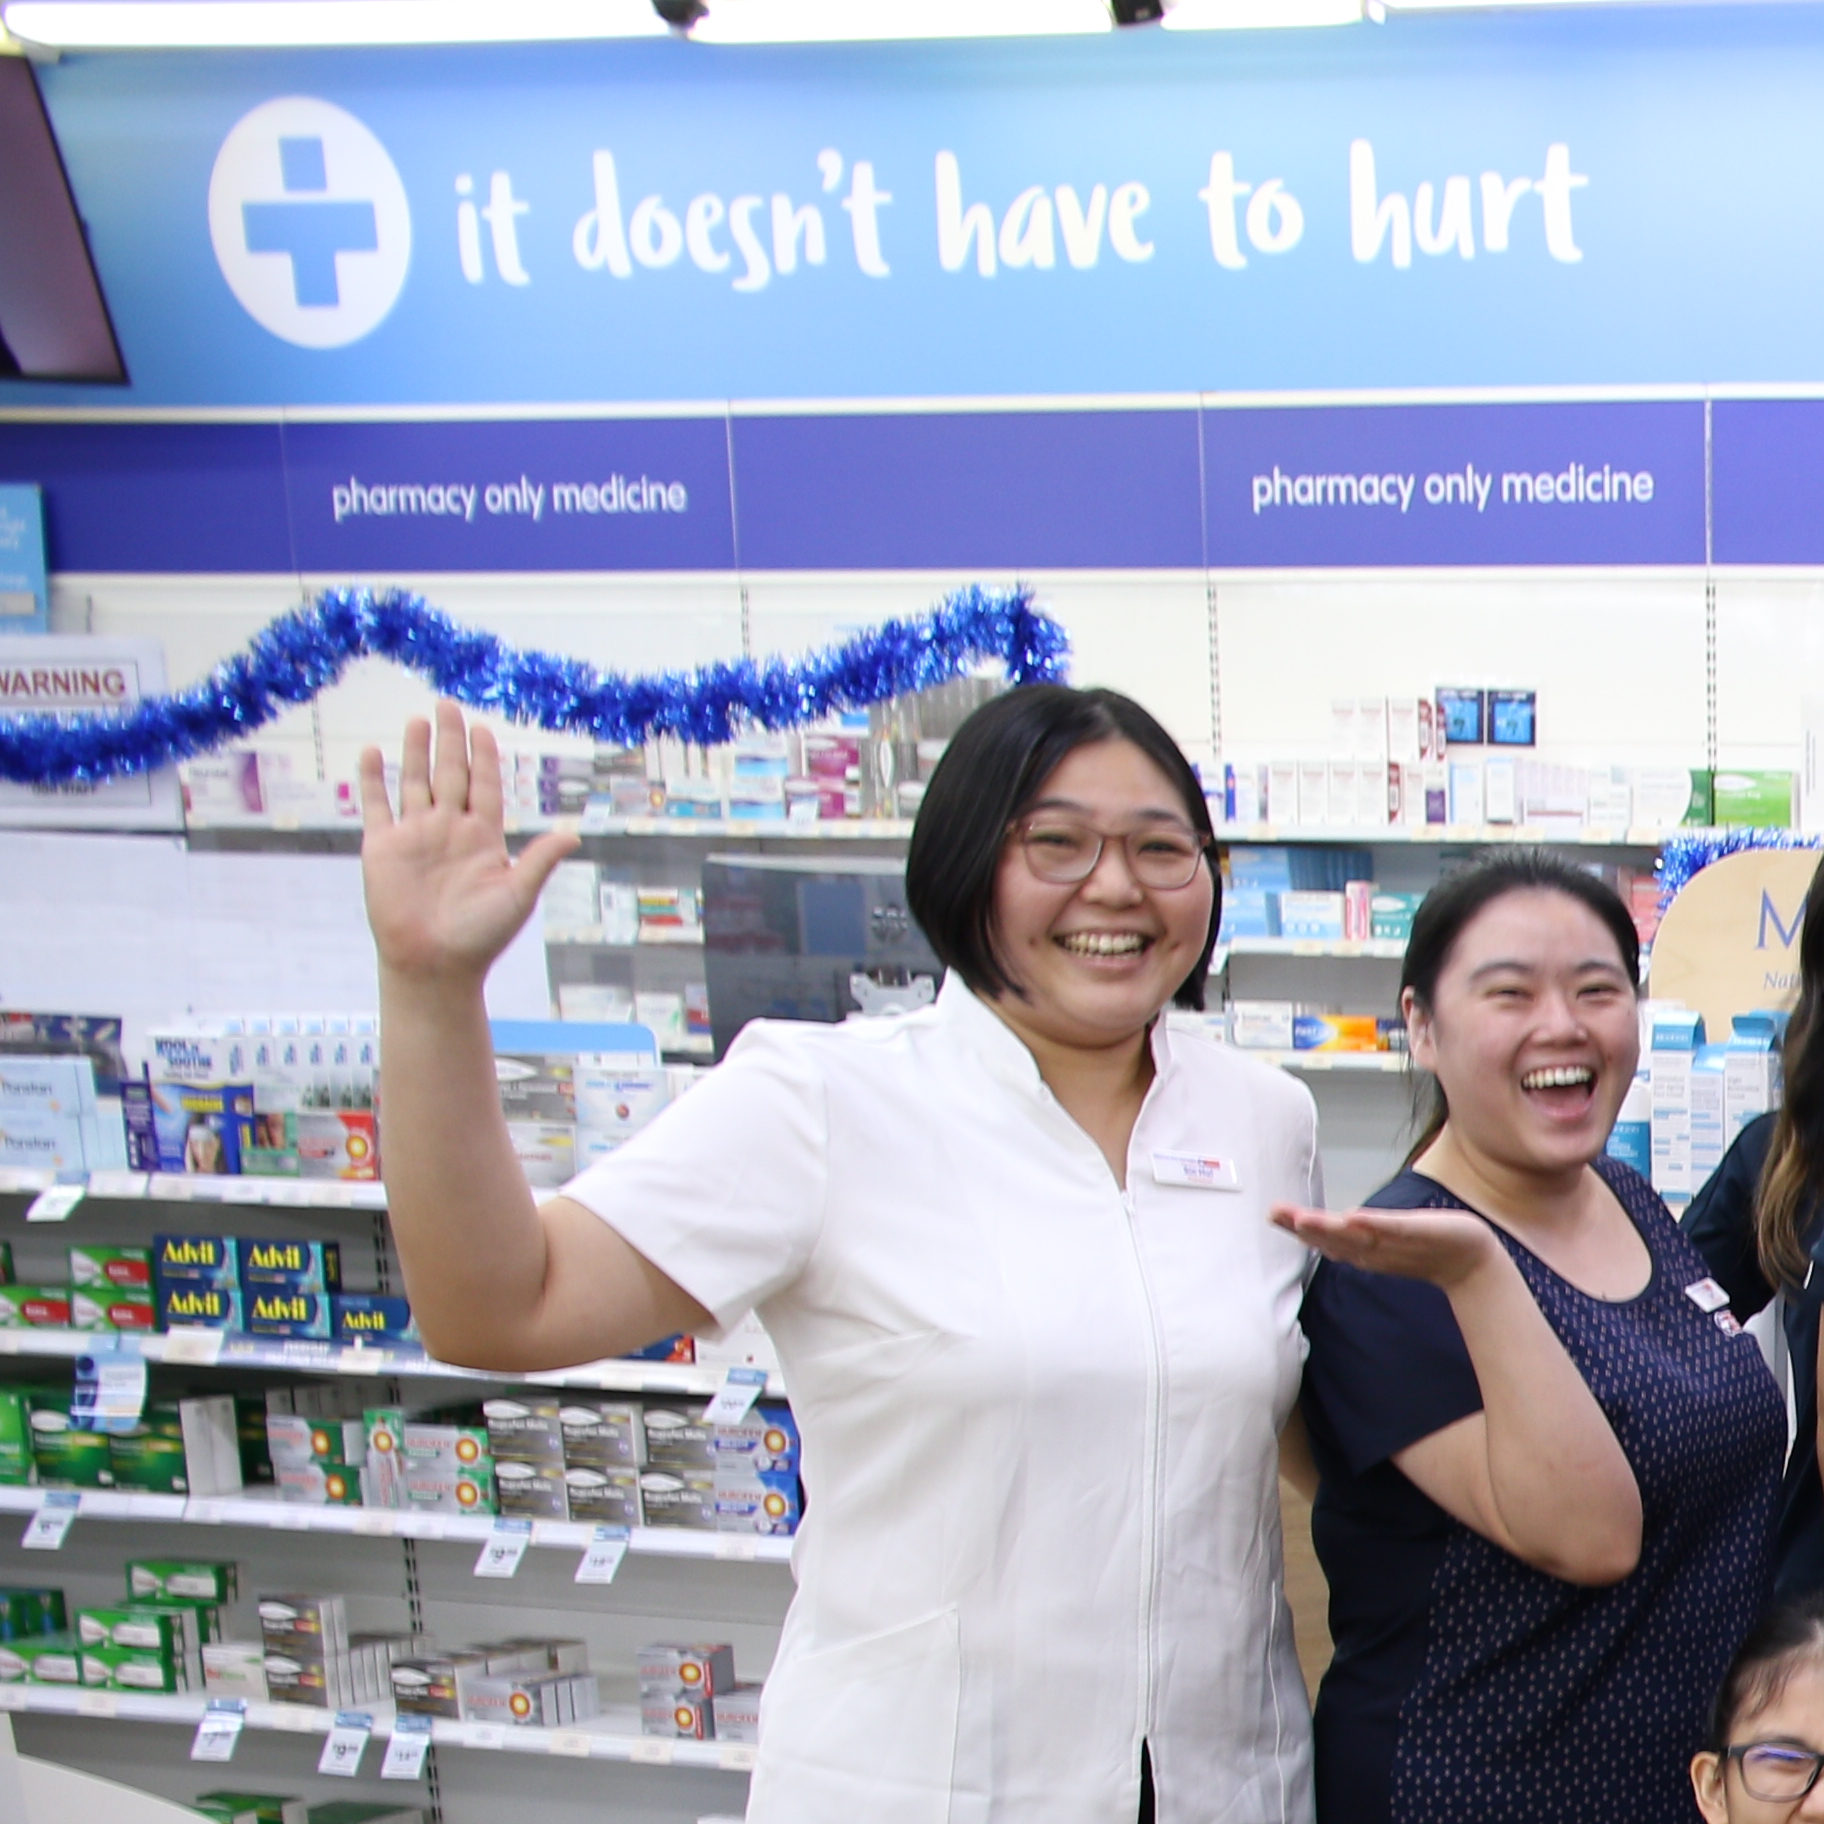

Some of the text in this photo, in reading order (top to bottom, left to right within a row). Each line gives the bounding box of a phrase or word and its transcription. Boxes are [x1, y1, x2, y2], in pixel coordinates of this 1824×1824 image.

[454, 138, 1590, 291] it doesn't have to hurt
[333, 475, 687, 523] pharmacy only medicine
[1252, 463, 1654, 513] pharmacy only medicine
[1, 1080, 52, 1096] Ponstan
[5, 1135, 56, 1151] Ponstan
[162, 1239, 215, 1267] Advil
[249, 1242, 301, 1271] Advil
[168, 1291, 220, 1318] Advil
[253, 1295, 307, 1322] Advil
[342, 1310, 387, 1331] Advil
